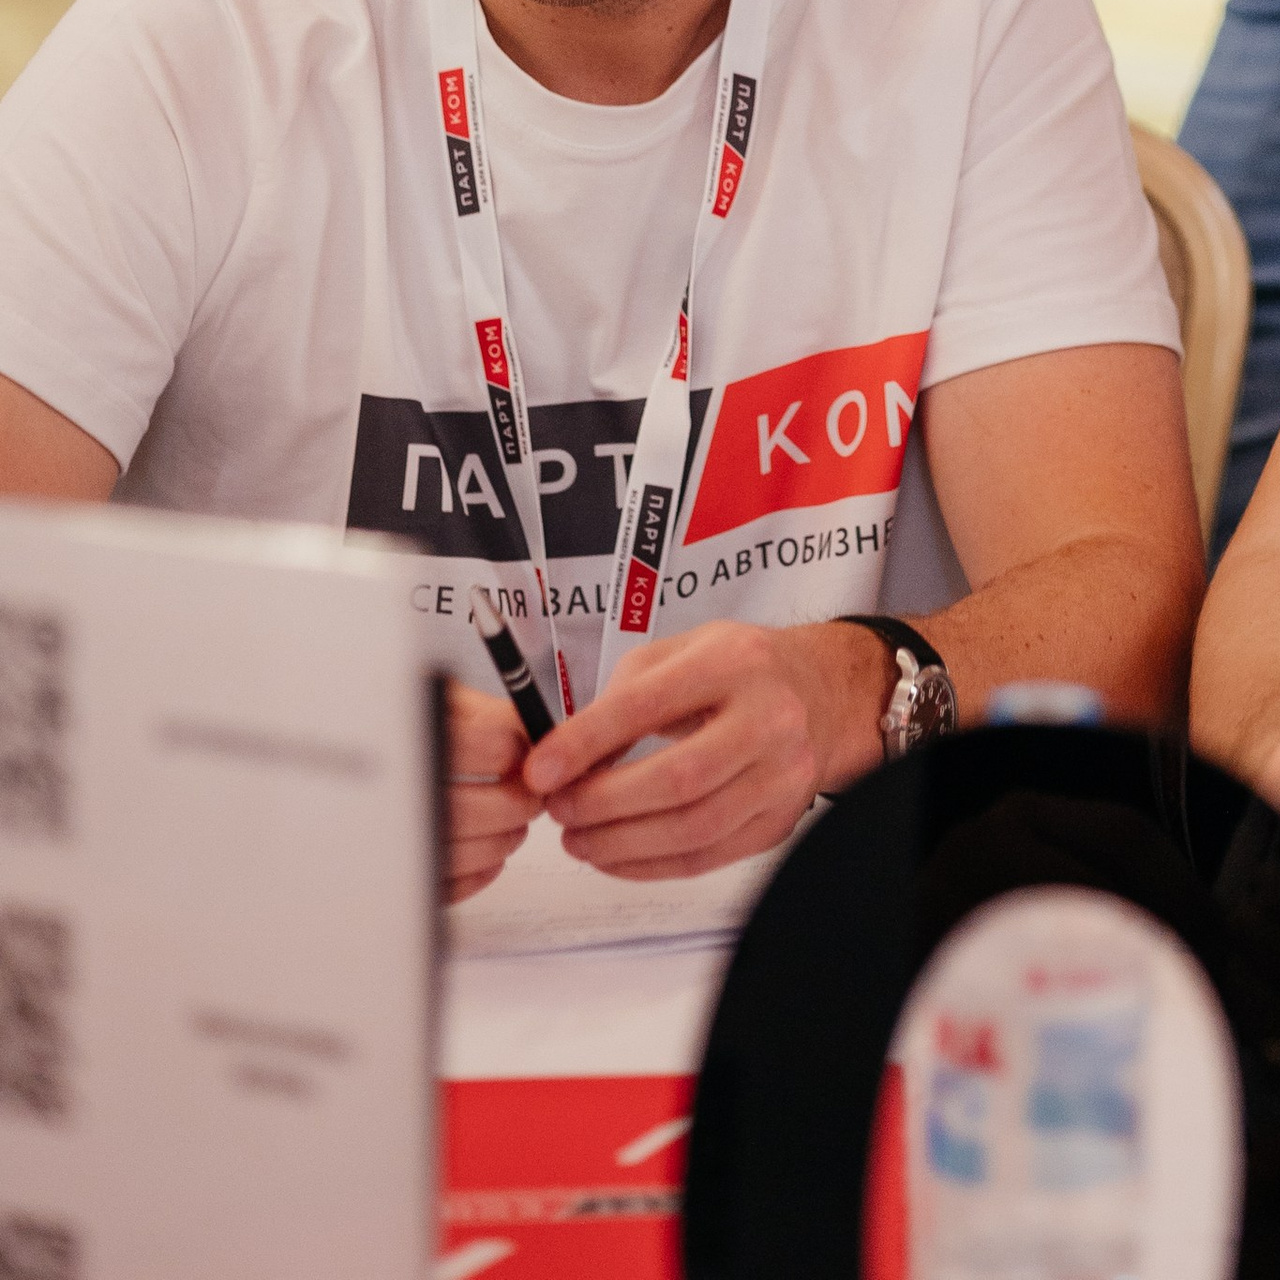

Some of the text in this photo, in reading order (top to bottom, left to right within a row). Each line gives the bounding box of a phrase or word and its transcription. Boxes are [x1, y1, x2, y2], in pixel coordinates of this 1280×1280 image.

[446, 75, 473, 206] ПАРТ КОМ
[717, 82, 751, 210] ПАРТ КОМ
[484, 325, 517, 455] ПАРТ КОМ
[403, 444, 640, 518] ПАРТ
[628, 493, 664, 625] ПАРТ КОМ
